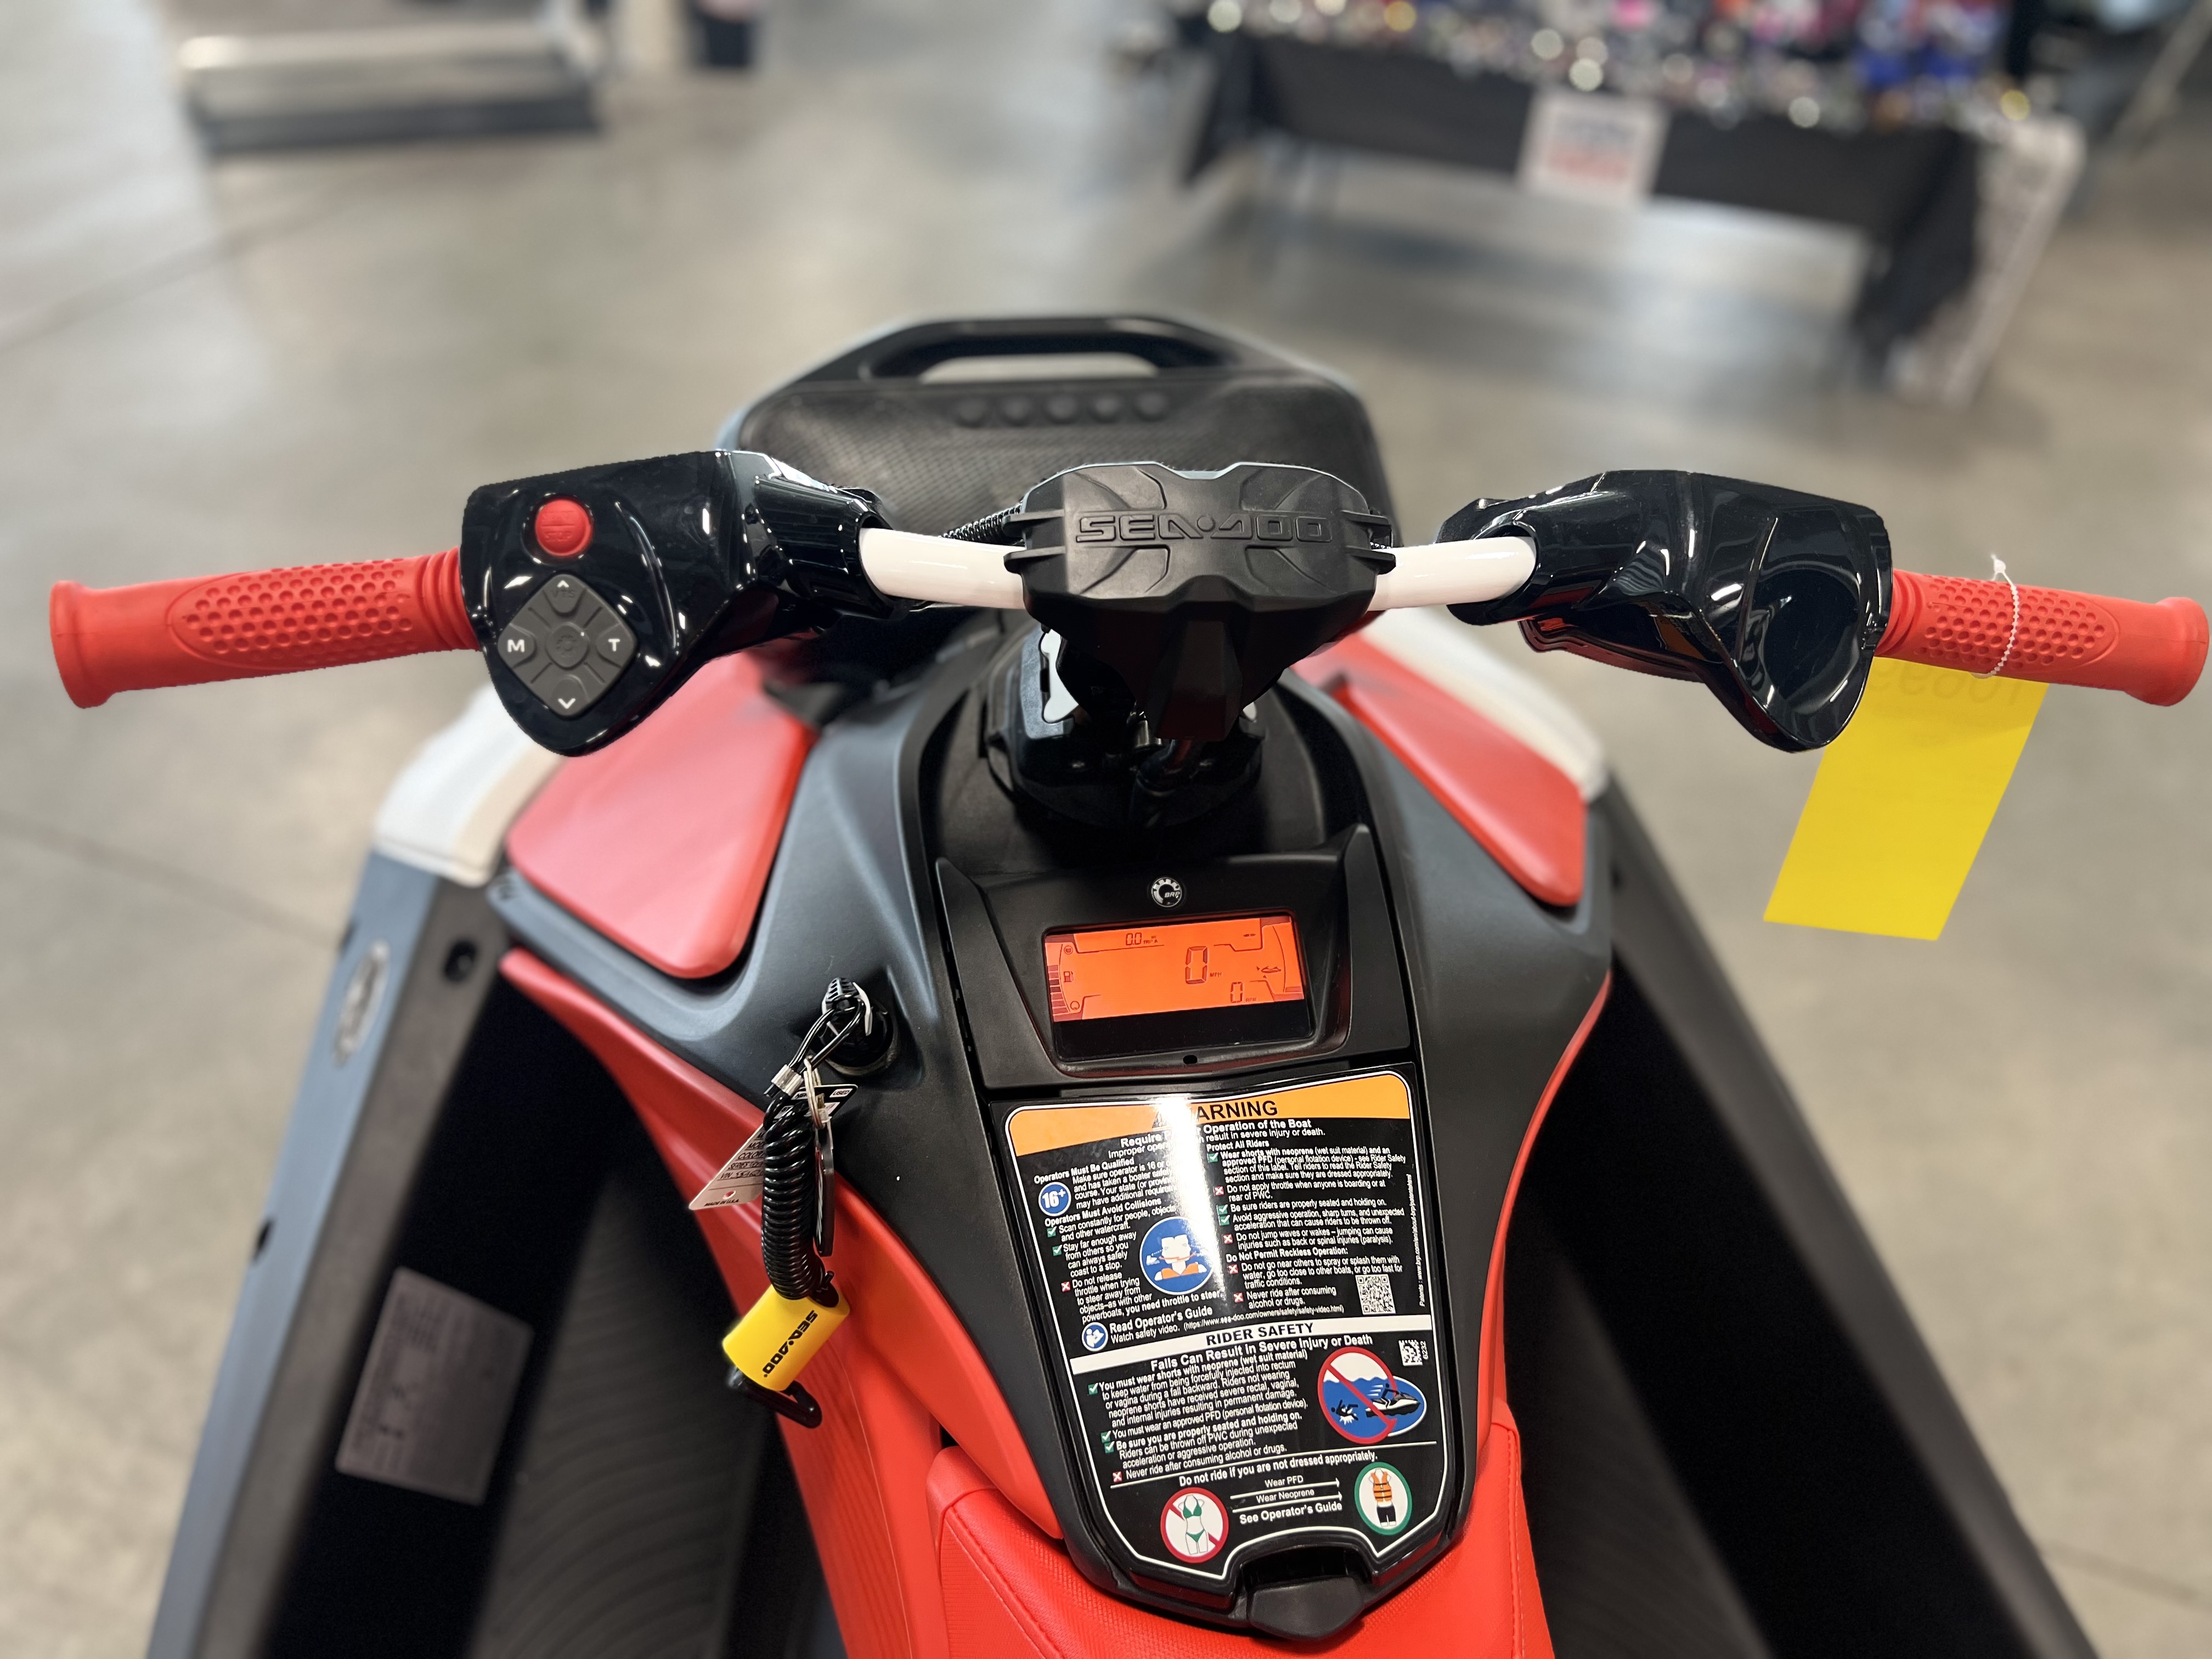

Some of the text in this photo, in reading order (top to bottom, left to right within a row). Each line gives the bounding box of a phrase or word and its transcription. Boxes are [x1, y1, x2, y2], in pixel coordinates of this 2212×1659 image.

[507, 639, 525, 652] M
[608, 639, 620, 652] T
[1186, 946, 1207, 985] 0
[1231, 981, 1243, 1003] 0
[1196, 1100, 1278, 1120] ARNING
[1203, 1119, 1312, 1135] Operation of the Boat
[1205, 1132, 1229, 1142] result
[1268, 1128, 1290, 1138] injury
[1301, 1127, 1325, 1136] death.
[1108, 1144, 1145, 1159] Improper
[1206, 1139, 1269, 1152] Protect All Riders
[1034, 1156, 1135, 1184] Operators Must Be Qualified
[1042, 1188, 1066, 1209] 16+
[1230, 1204, 1240, 1212] Be
[1291, 1199, 1317, 1209] properly
[1318, 1198, 1340, 1207] seated
[1353, 1198, 1376, 1207] holding
[1045, 1198, 1161, 1227] Operators Must Avoid Collisions
[1061, 1221, 1130, 1242] and other watercraft.
[1226, 1246, 1348, 1262] Do Not Permit Reckless Operation:
[1070, 1266, 1089, 1277] coast
[1104, 1261, 1122, 1270] stop.
[1071, 1272, 1122, 1288] Do not release
[1074, 1277, 1139, 1296] throttle when trying
[1244, 1277, 1302, 1289] traffic conditions.
[1246, 1286, 1336, 1300] Never ride after consuming
[1082, 1308, 1124, 1324] powerboats,
[1125, 1305, 1140, 1316] you
[1141, 1300, 1160, 1311] need
[1161, 1295, 1189, 1307] throttle
[1190, 1294, 1199, 1302] to
[1248, 1299, 1274, 1309] alcohol
[1284, 1297, 1305, 1306] drugs.
[1109, 1306, 1212, 1333] Read Operator's Guide
[1110, 1332, 1134, 1343] Watch
[1135, 1328, 1156, 1339] safety
[1158, 1324, 1180, 1334] video.
[1206, 1322, 1313, 1345] RIDER SAFETY
[1150, 1334, 1373, 1371] Falls Can Result In Severe Injury or Death
[1112, 1429, 1126, 1439] You
[1127, 1425, 1144, 1436] must
[1144, 1423, 1161, 1432] wear
[1172, 1414, 1204, 1429] approved
[1205, 1411, 1221, 1421] PFD
[1222, 1406, 1254, 1420] (personal
[1254, 1402, 1282, 1413] flotation
[1282, 1398, 1308, 1409] device).
[1116, 1441, 1127, 1450] Be
[1128, 1438, 1146, 1448] sure
[1147, 1435, 1162, 1446] you
[1164, 1432, 1176, 1441] are
[1177, 1425, 1212, 1440] properly
[1212, 1419, 1239, 1432] seated
[1241, 1417, 1256, 1427] and
[1257, 1413, 1288, 1424] holding
[1122, 1453, 1166, 1469] acceleration
[1177, 1444, 1216, 1459] aggressive
[1218, 1438, 1256, 1452] operation.
[1126, 1468, 1148, 1479] Never
[1149, 1465, 1163, 1475] ride
[1165, 1462, 1181, 1472] after
[1183, 1454, 1223, 1468] consuming
[1224, 1448, 1252, 1461] alcohol
[1263, 1444, 1287, 1454] drugs.
[1179, 1451, 1378, 1486] Do not ride if you are not dressed appropriately.
[1264, 1475, 1303, 1487] Wear PFD
[1256, 1489, 1314, 1503] Wear Neoprene
[1239, 1502, 1342, 1524] See Operator's Guide
